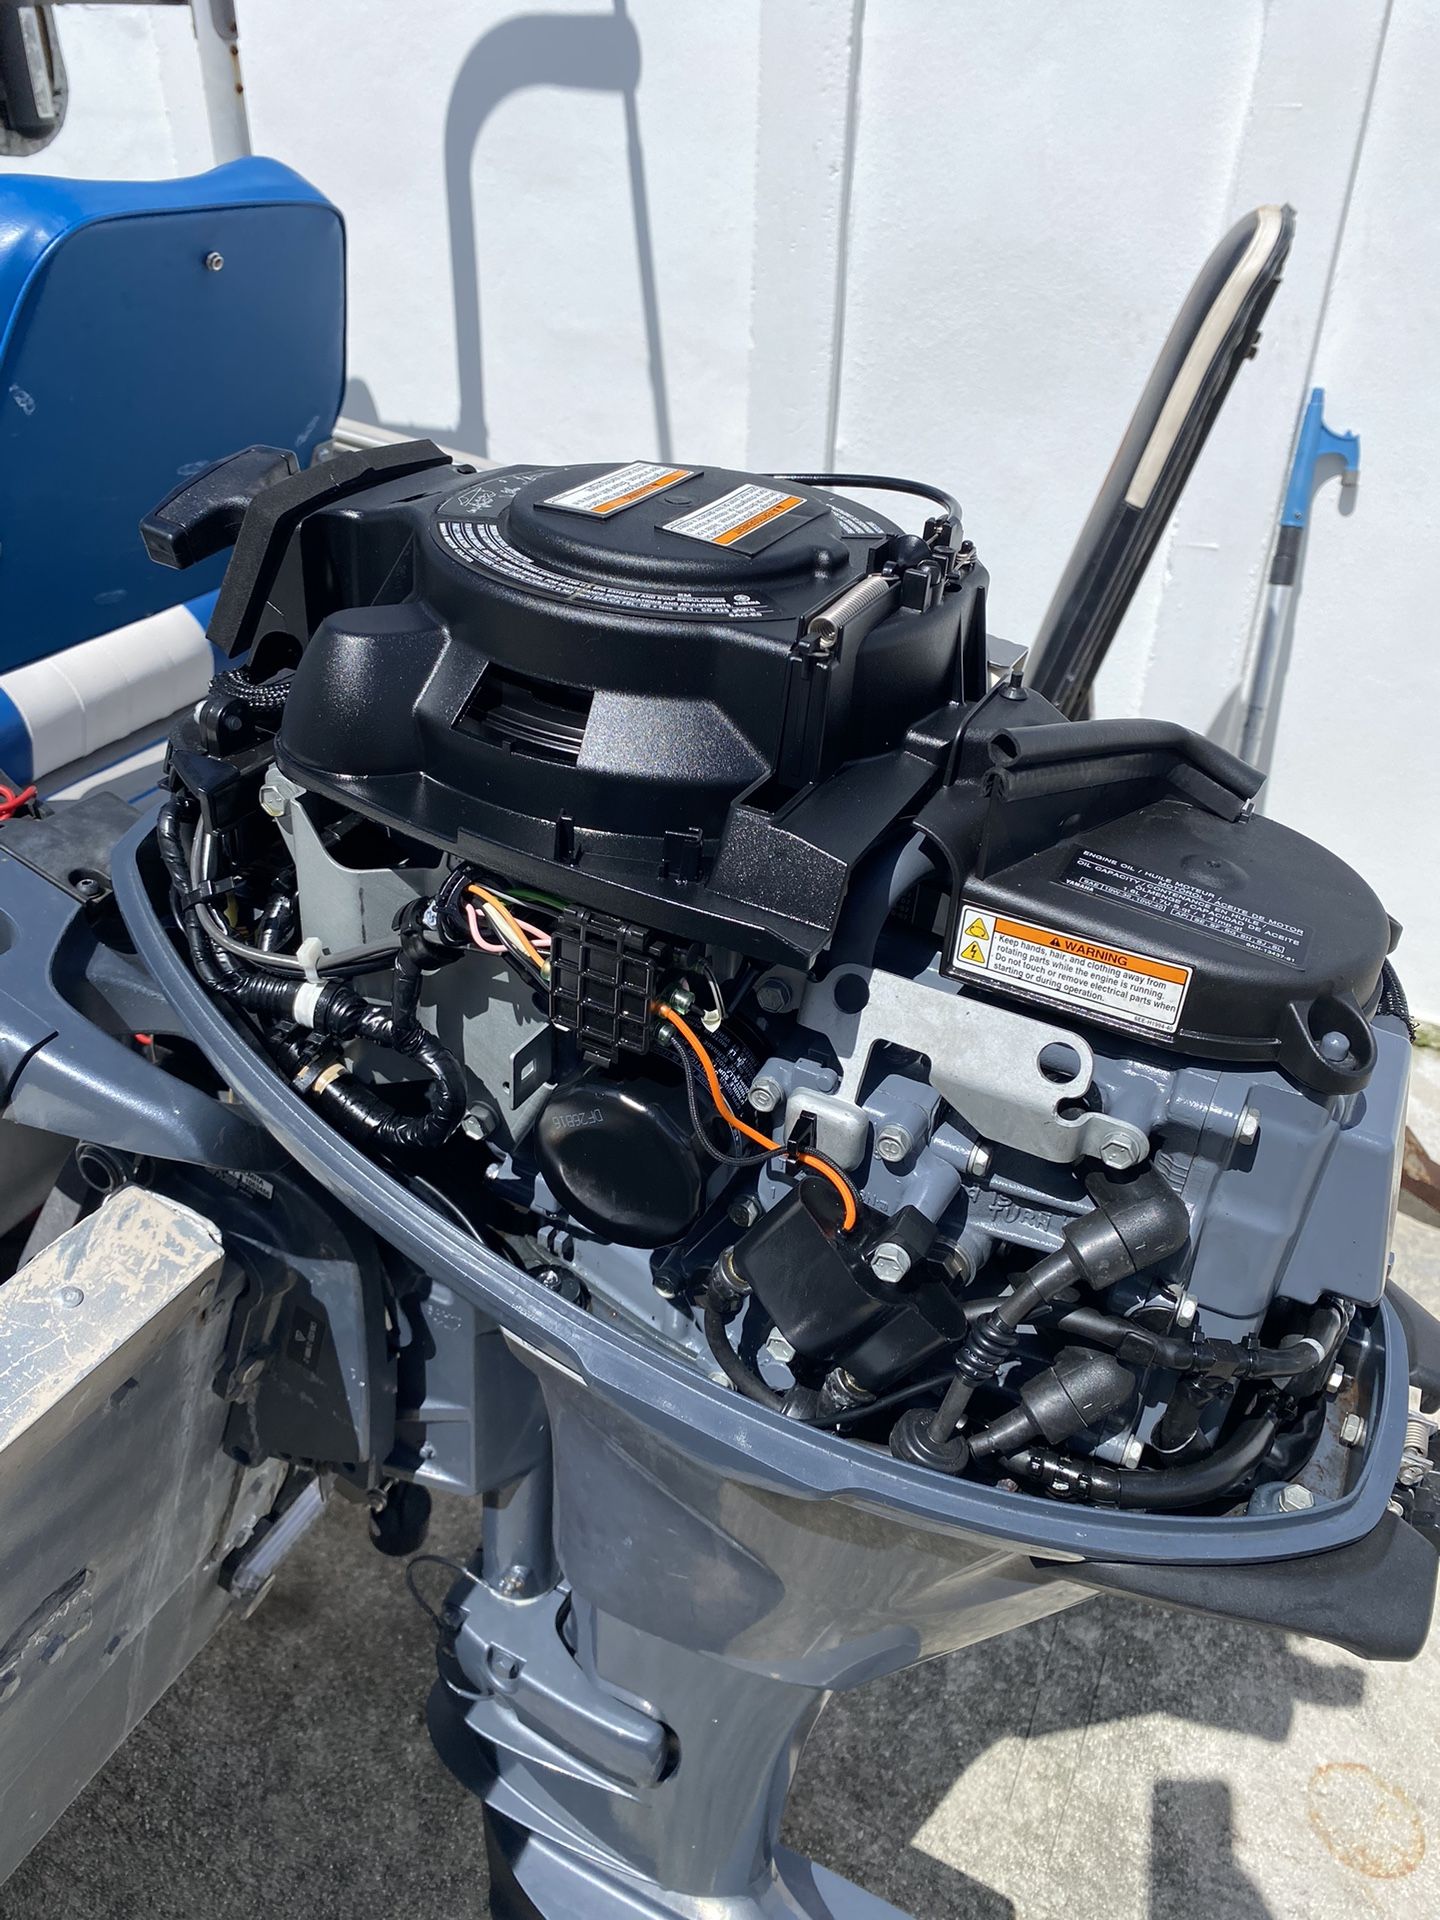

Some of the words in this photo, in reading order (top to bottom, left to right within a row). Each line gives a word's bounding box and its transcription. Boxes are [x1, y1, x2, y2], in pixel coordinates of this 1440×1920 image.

[1064, 878, 1094, 892] YAMAHA
[1076, 859, 1092, 868] OIL
[1094, 865, 1140, 884] CAPACITY
[1146, 883, 1211, 909] CONTENANCE
[1213, 906, 1228, 914] EN
[1230, 912, 1259, 925] HUILE
[1082, 850, 1117, 865] ENGINE
[1119, 863, 1135, 871] OIL
[1174, 881, 1215, 898] MOTEUR
[1188, 903, 1245, 926] CAPACIDAD
[1247, 924, 1261, 932] DE
[1264, 930, 1300, 946] ACEITE
[1213, 900, 1248, 915] ACEITE
[1250, 912, 1265, 921] DE
[1267, 918, 1304, 934] MOTOR
[996, 943, 1027, 960] rotating
[1029, 953, 1050, 966] parts
[1052, 960, 1073, 972] while
[1075, 967, 1088, 976] the
[1089, 971, 1118, 987] engine
[1120, 980, 1128, 988] is
[1129, 982, 1165, 1001] running.
[998, 934, 1019, 948] Keep
[1020, 941, 1048, 955] hands,
[1049, 949, 1068, 961] hair,
[1069, 955, 1085, 966] and
[1086, 960, 1121, 978] clothing
[1122, 971, 1144, 985] away
[1146, 977, 1166, 989] from
[1064, 940, 1128, 966] WARNING
[993, 961, 1023, 979] starting
[1025, 972, 1034, 980] or
[1035, 974, 1061, 990] during
[1063, 982, 1104, 1004] operation.
[995, 952, 1006, 962] Do
[1008, 957, 1021, 966] not
[1022, 961, 1045, 974] touch
[1057, 972, 1088, 986] remove
[1090, 980, 1128, 998] electrical
[1129, 993, 1151, 1007] parts
[1153, 999, 1176, 1013] when
